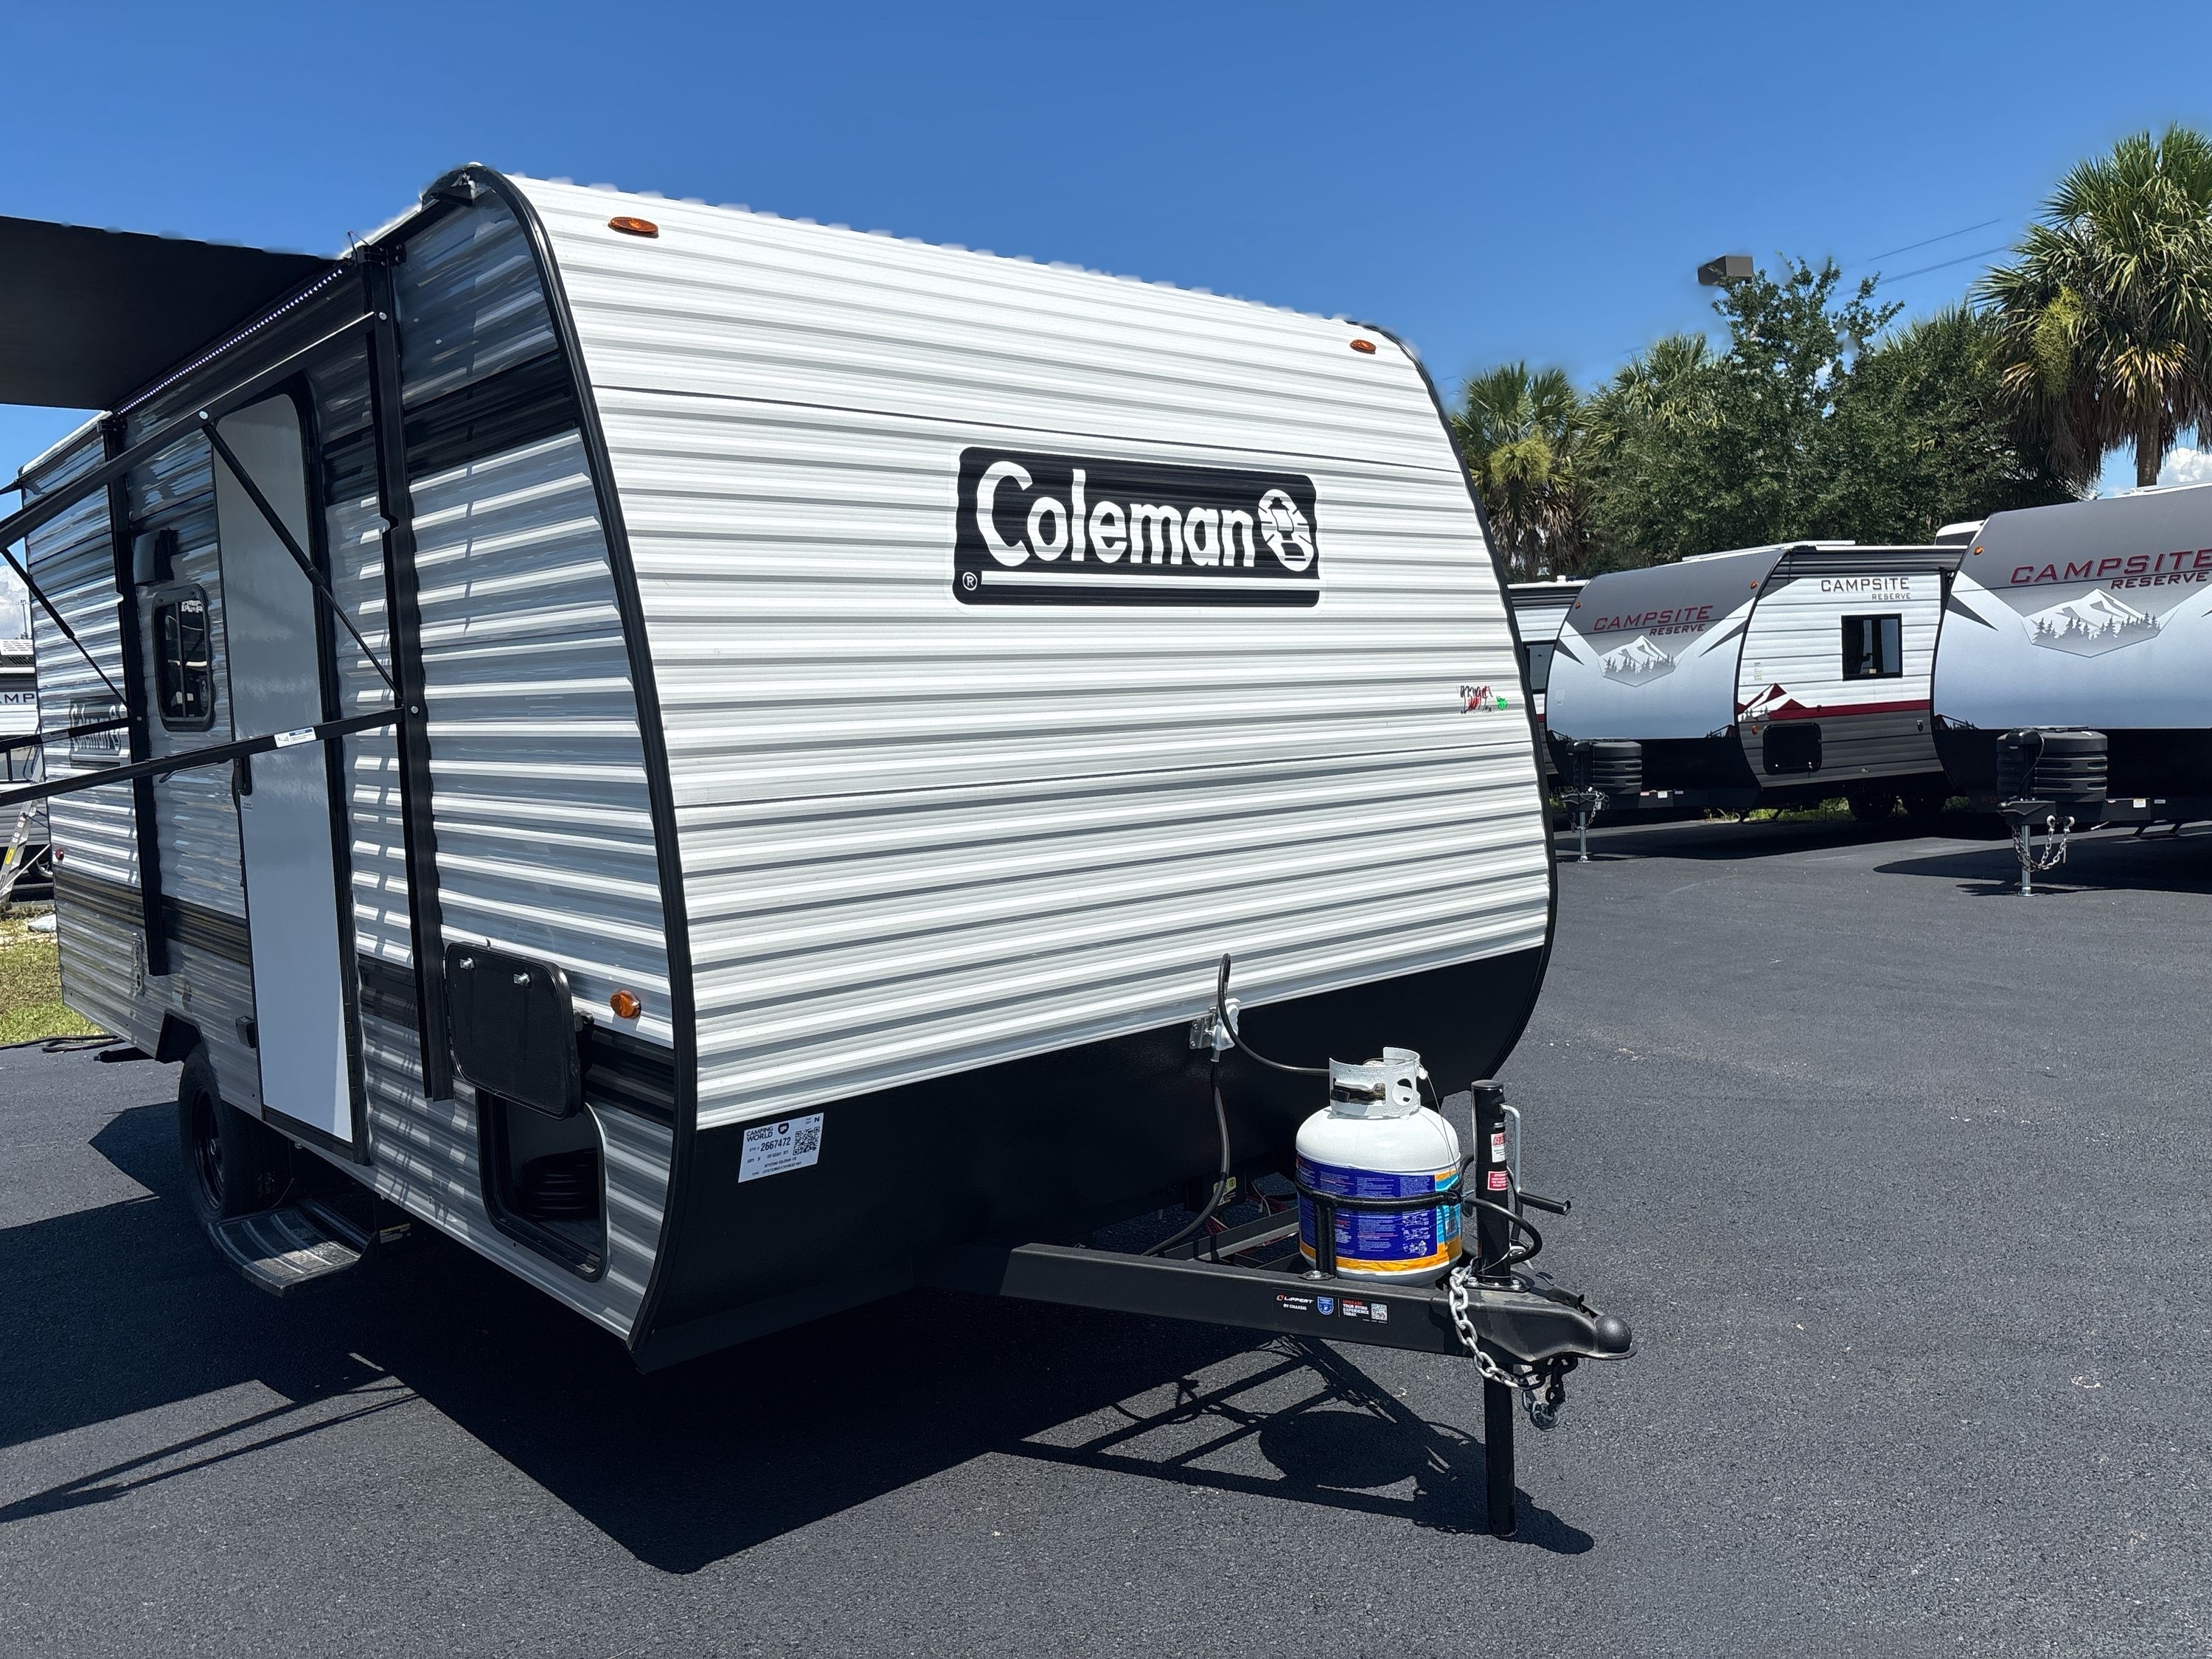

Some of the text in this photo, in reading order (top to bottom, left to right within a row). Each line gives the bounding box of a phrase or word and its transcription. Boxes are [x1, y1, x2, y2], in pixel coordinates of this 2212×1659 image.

[976, 460, 1256, 567] Coleman
[2010, 548, 2212, 585] CAMPSITE
[1820, 577, 1910, 592] CAMPSITE
[2110, 571, 2210, 590] RESERVE
[1871, 592, 1912, 601] RESERVE
[1593, 605, 1714, 632] CAMPSITE
[1649, 623, 1706, 637] RESERVE
[0, 693, 35, 703] MP
[746, 1126, 773, 1137] CAMPING
[746, 1132, 773, 1142] WORLD
[760, 1137, 791, 1152] 2667472
